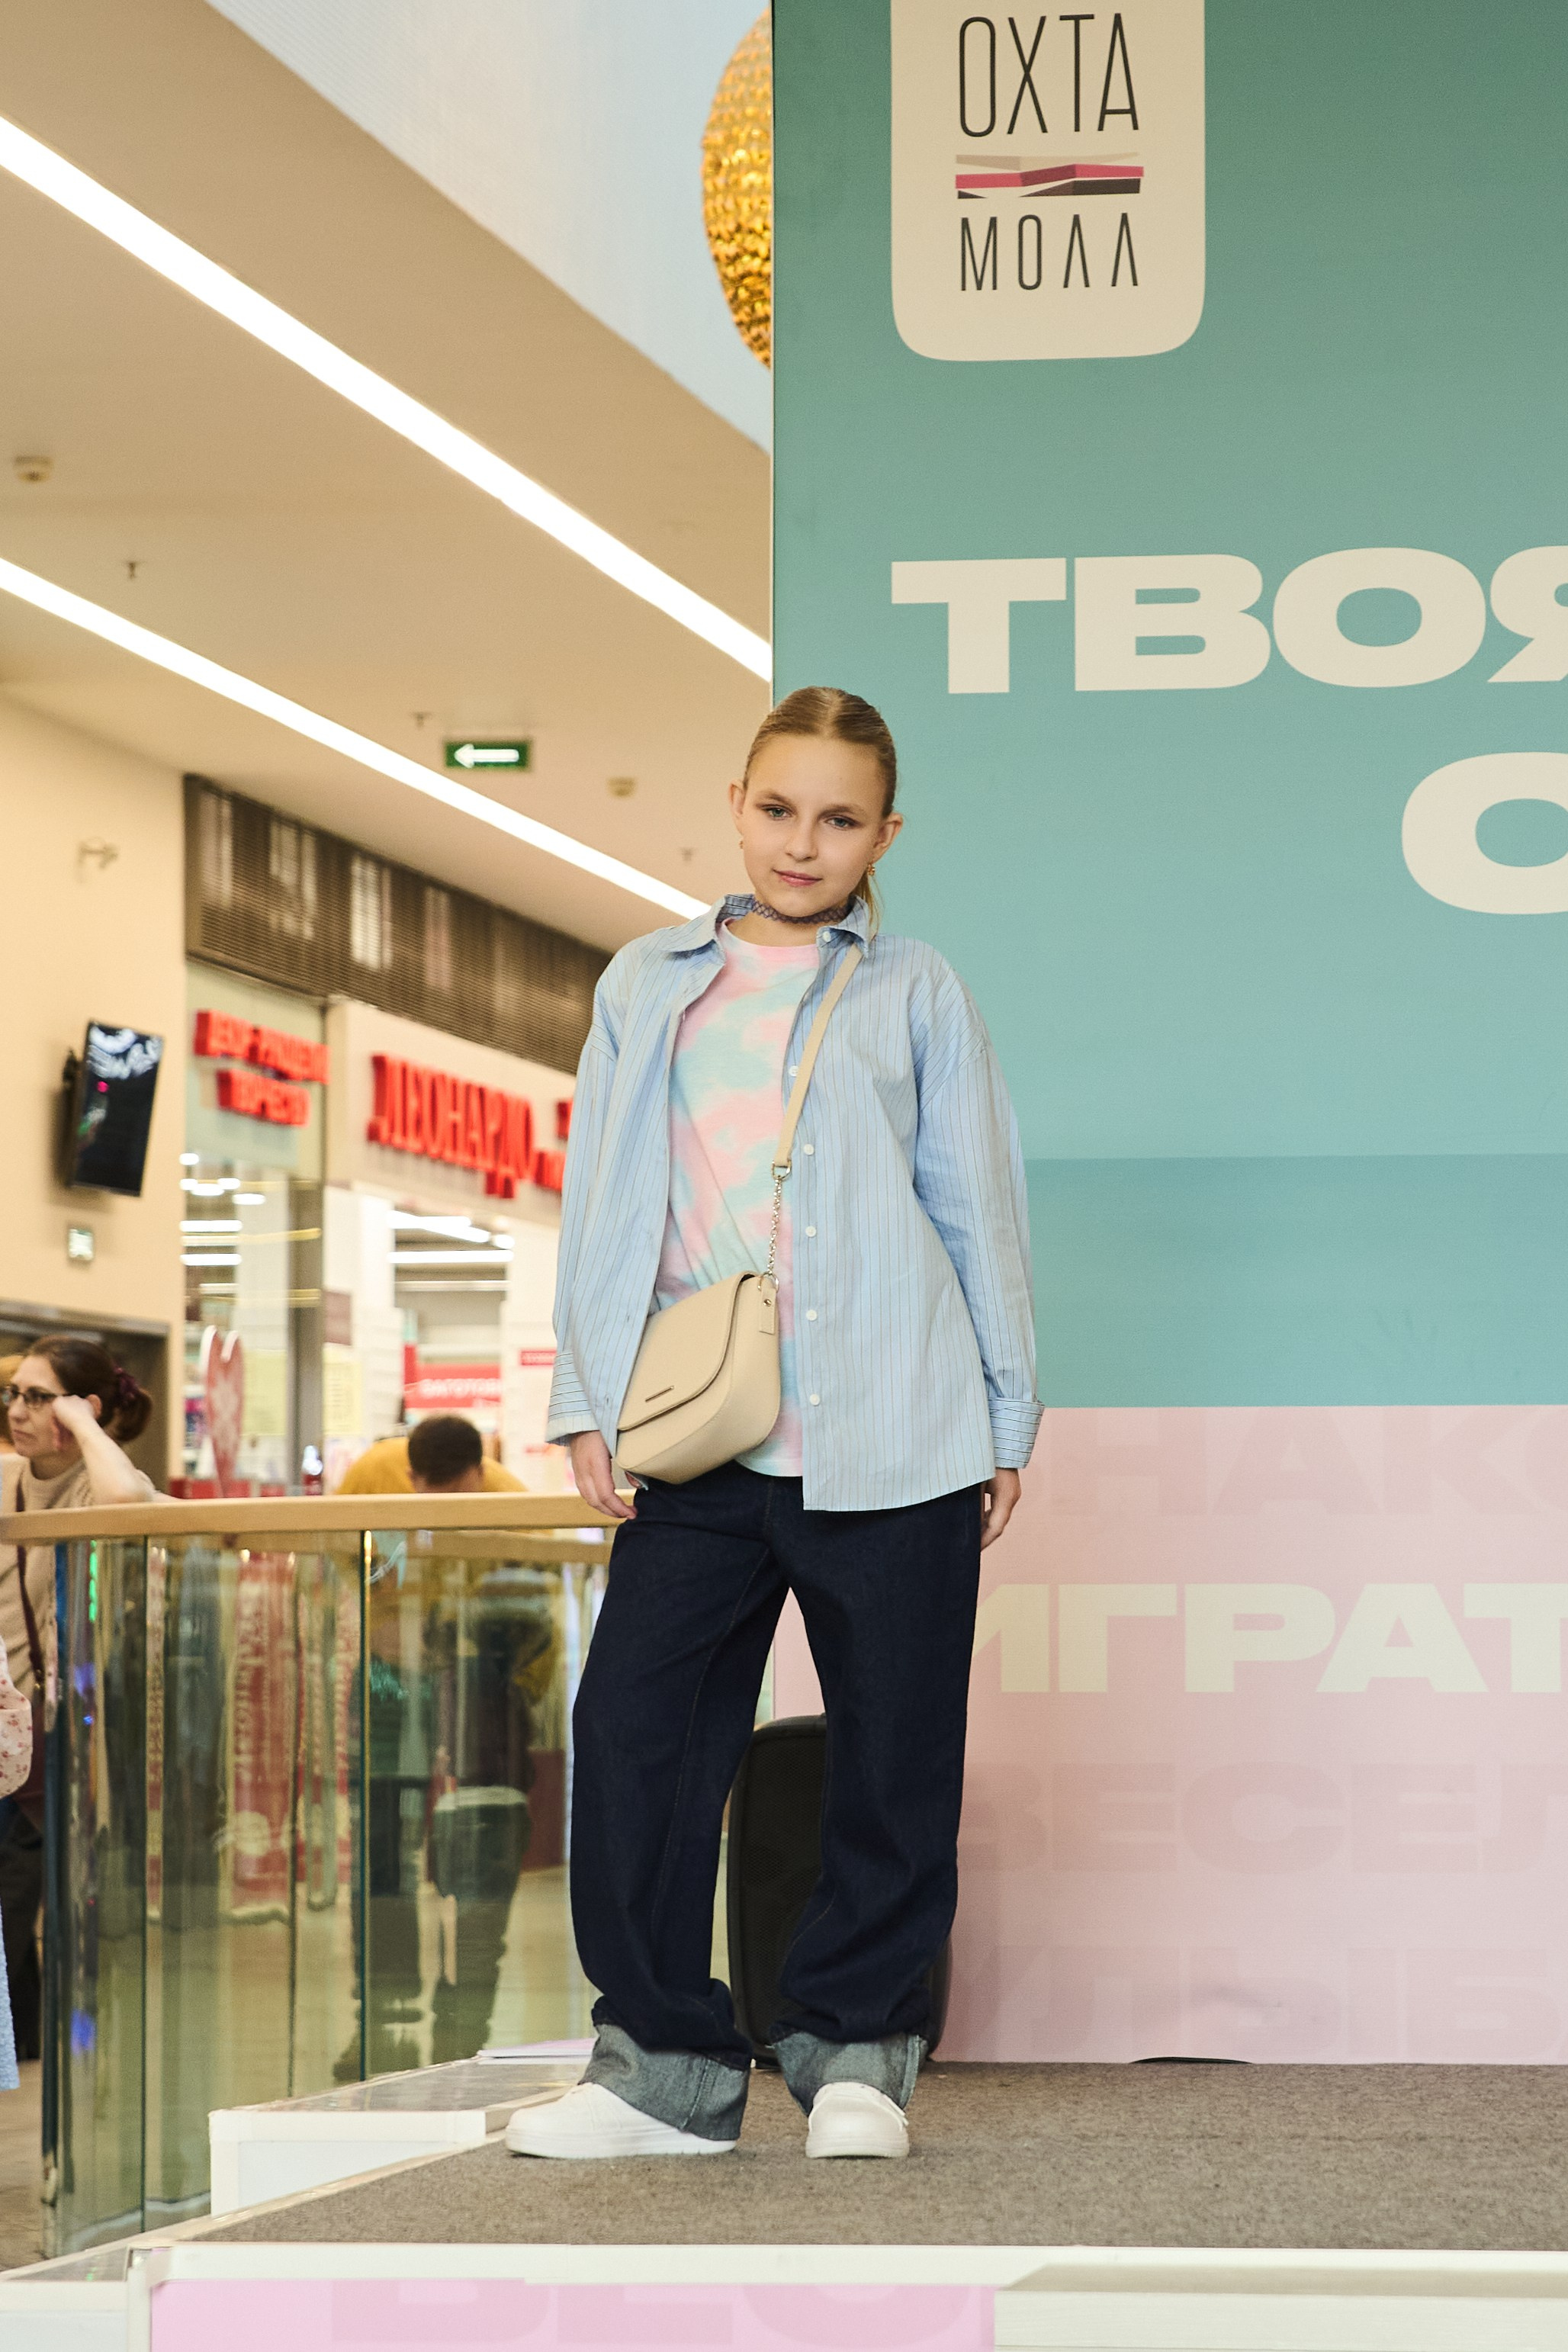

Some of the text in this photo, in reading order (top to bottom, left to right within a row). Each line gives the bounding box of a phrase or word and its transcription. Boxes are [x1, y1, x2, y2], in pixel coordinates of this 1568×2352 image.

[958, 11, 1140, 138] ОХТА
[959, 212, 1139, 291] МОЛЛ
[1028, 1406, 1568, 1515] НАК
